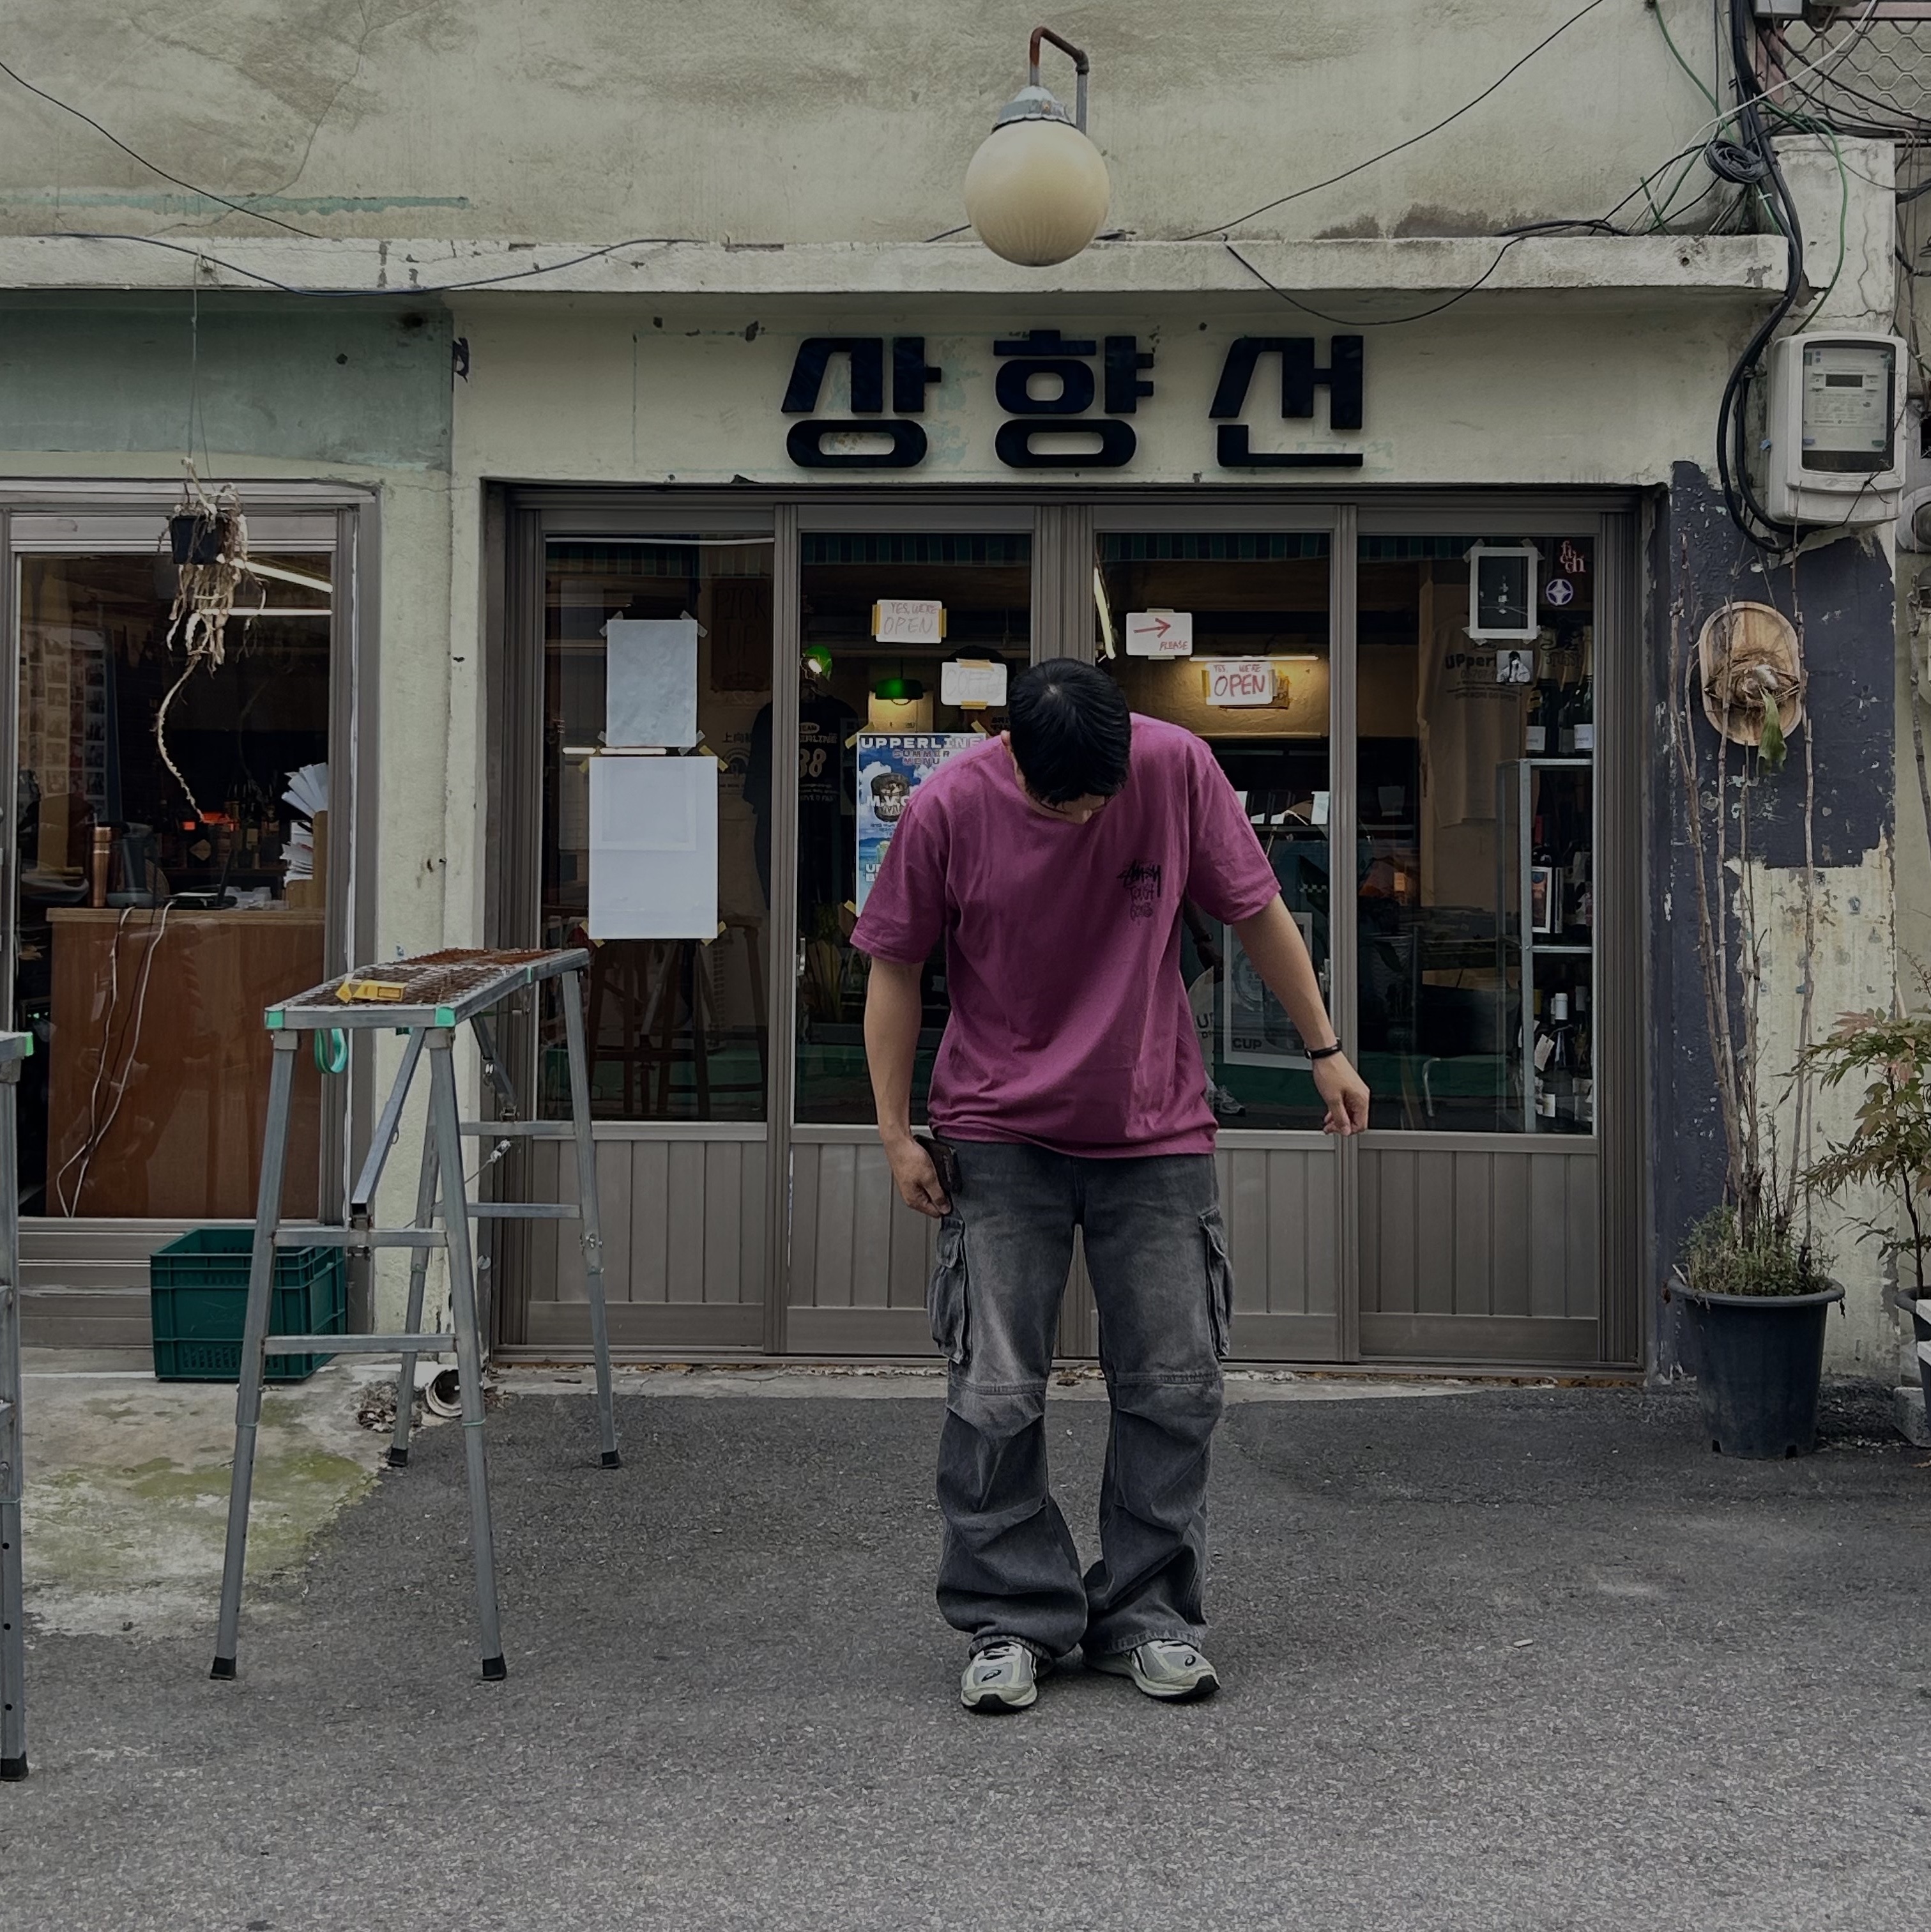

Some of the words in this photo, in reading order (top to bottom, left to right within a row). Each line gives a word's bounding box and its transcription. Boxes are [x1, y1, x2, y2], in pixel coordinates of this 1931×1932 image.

[781, 330, 1363, 468] 상향선
[715, 586, 768, 620] PICK
[883, 617, 933, 634] OPEN
[1159, 640, 1189, 651] PLEASE
[1214, 675, 1265, 697] OPEN
[860, 737, 984, 749] UPPERLINE
[892, 749, 950, 759] SUMMER
[902, 758, 940, 766] MENU
[1232, 1038, 1262, 1050] CUP
